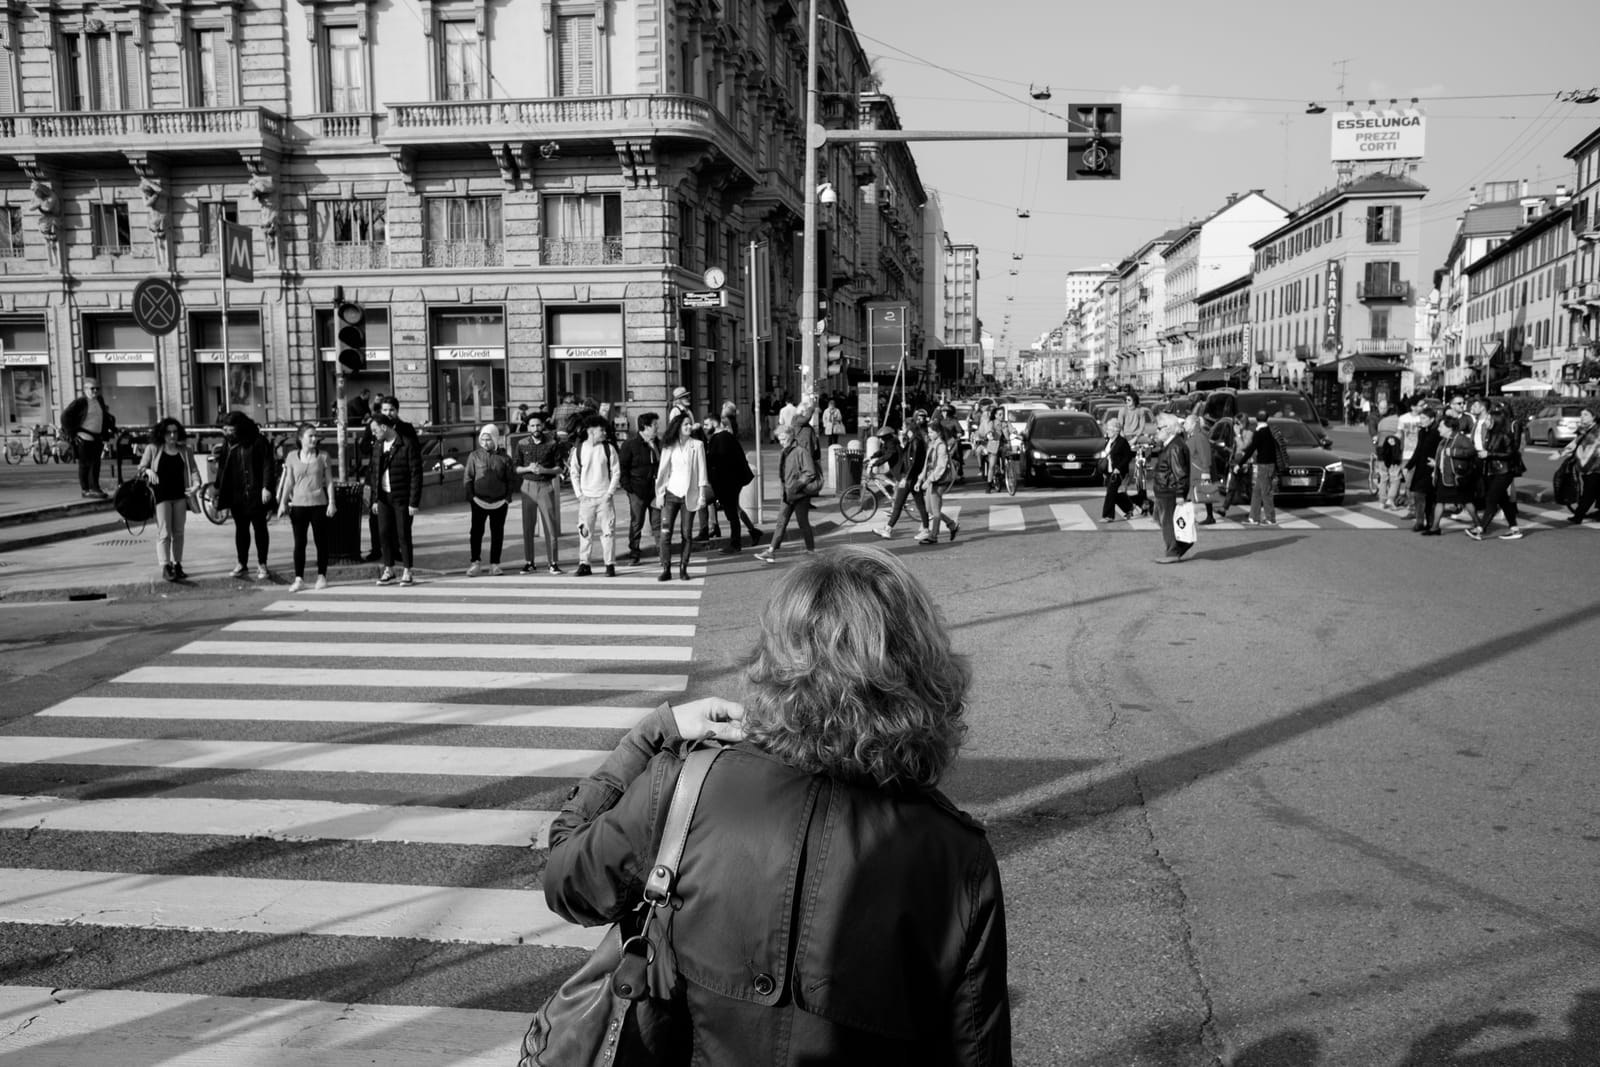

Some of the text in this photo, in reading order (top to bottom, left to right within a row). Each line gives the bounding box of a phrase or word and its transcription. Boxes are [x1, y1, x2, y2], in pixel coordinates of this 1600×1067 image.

[1337, 116, 1420, 129] ESSELUNGA
[1355, 131, 1400, 142] PREZZI
[1359, 142, 1397, 152] CORTI
[230, 236, 251, 270] M
[1327, 262, 1337, 335] FARMACIA
[458, 350, 490, 358] UniCredit
[574, 348, 607, 357] UniCredit
